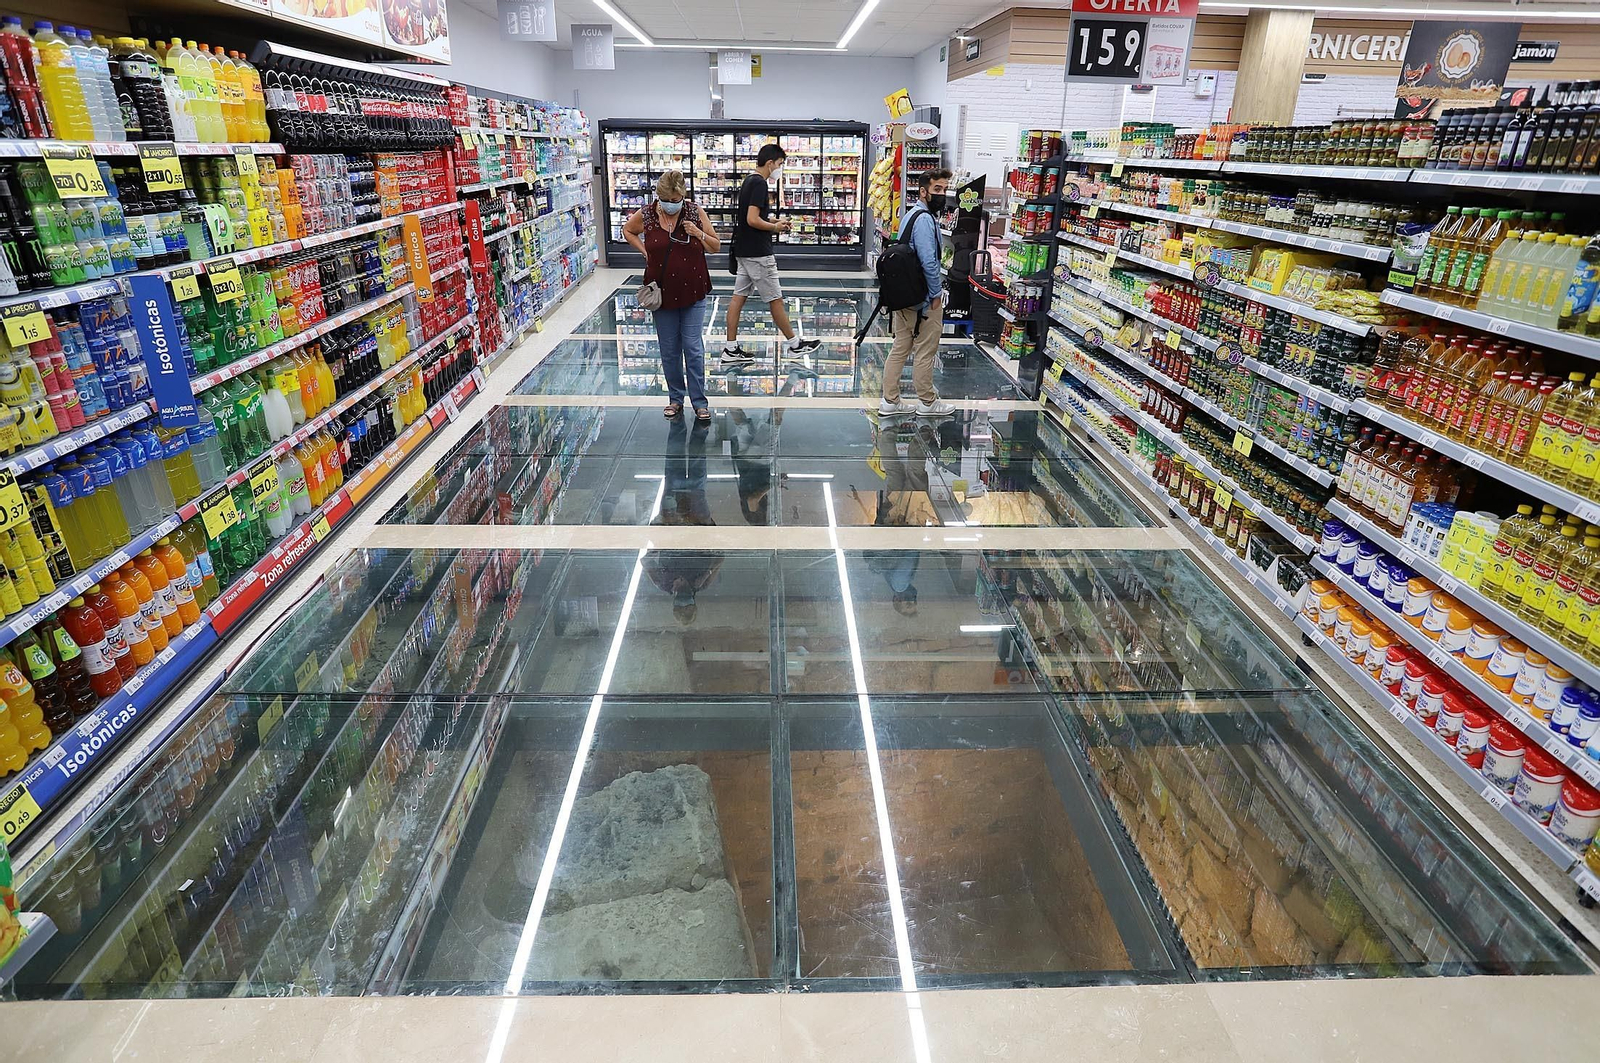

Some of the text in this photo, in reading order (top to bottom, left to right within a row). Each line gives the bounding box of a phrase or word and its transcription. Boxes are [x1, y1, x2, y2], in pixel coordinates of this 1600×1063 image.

[581, 29, 603, 37] AGUA
[1305, 30, 1411, 62] RNICERÍ
[1513, 42, 1556, 60] jamón
[917, 127, 933, 135] eliges
[75, 172, 104, 193] 0,36
[147, 169, 183, 185] 2x1 0,55
[472, 218, 480, 241] Colas
[410, 231, 423, 270] Cítricos
[180, 285, 193, 296] 1,29
[215, 282, 228, 295] 3x2
[11, 303, 37, 314] ¡PRECIO!
[19, 325, 39, 340] 1,15
[146, 299, 175, 375] Isotónicas
[161, 404, 194, 415] AQUARIUS
[264, 477, 279, 492] 0,39
[0, 503, 24, 526] 0,37
[219, 510, 236, 525] 1,38
[260, 531, 317, 588] Zona refrescant
[224, 591, 238, 604] Zona
[57, 702, 138, 779] Isotónicas
[0, 787, 21, 811] RECIO!
[3, 811, 30, 836] 0,49
